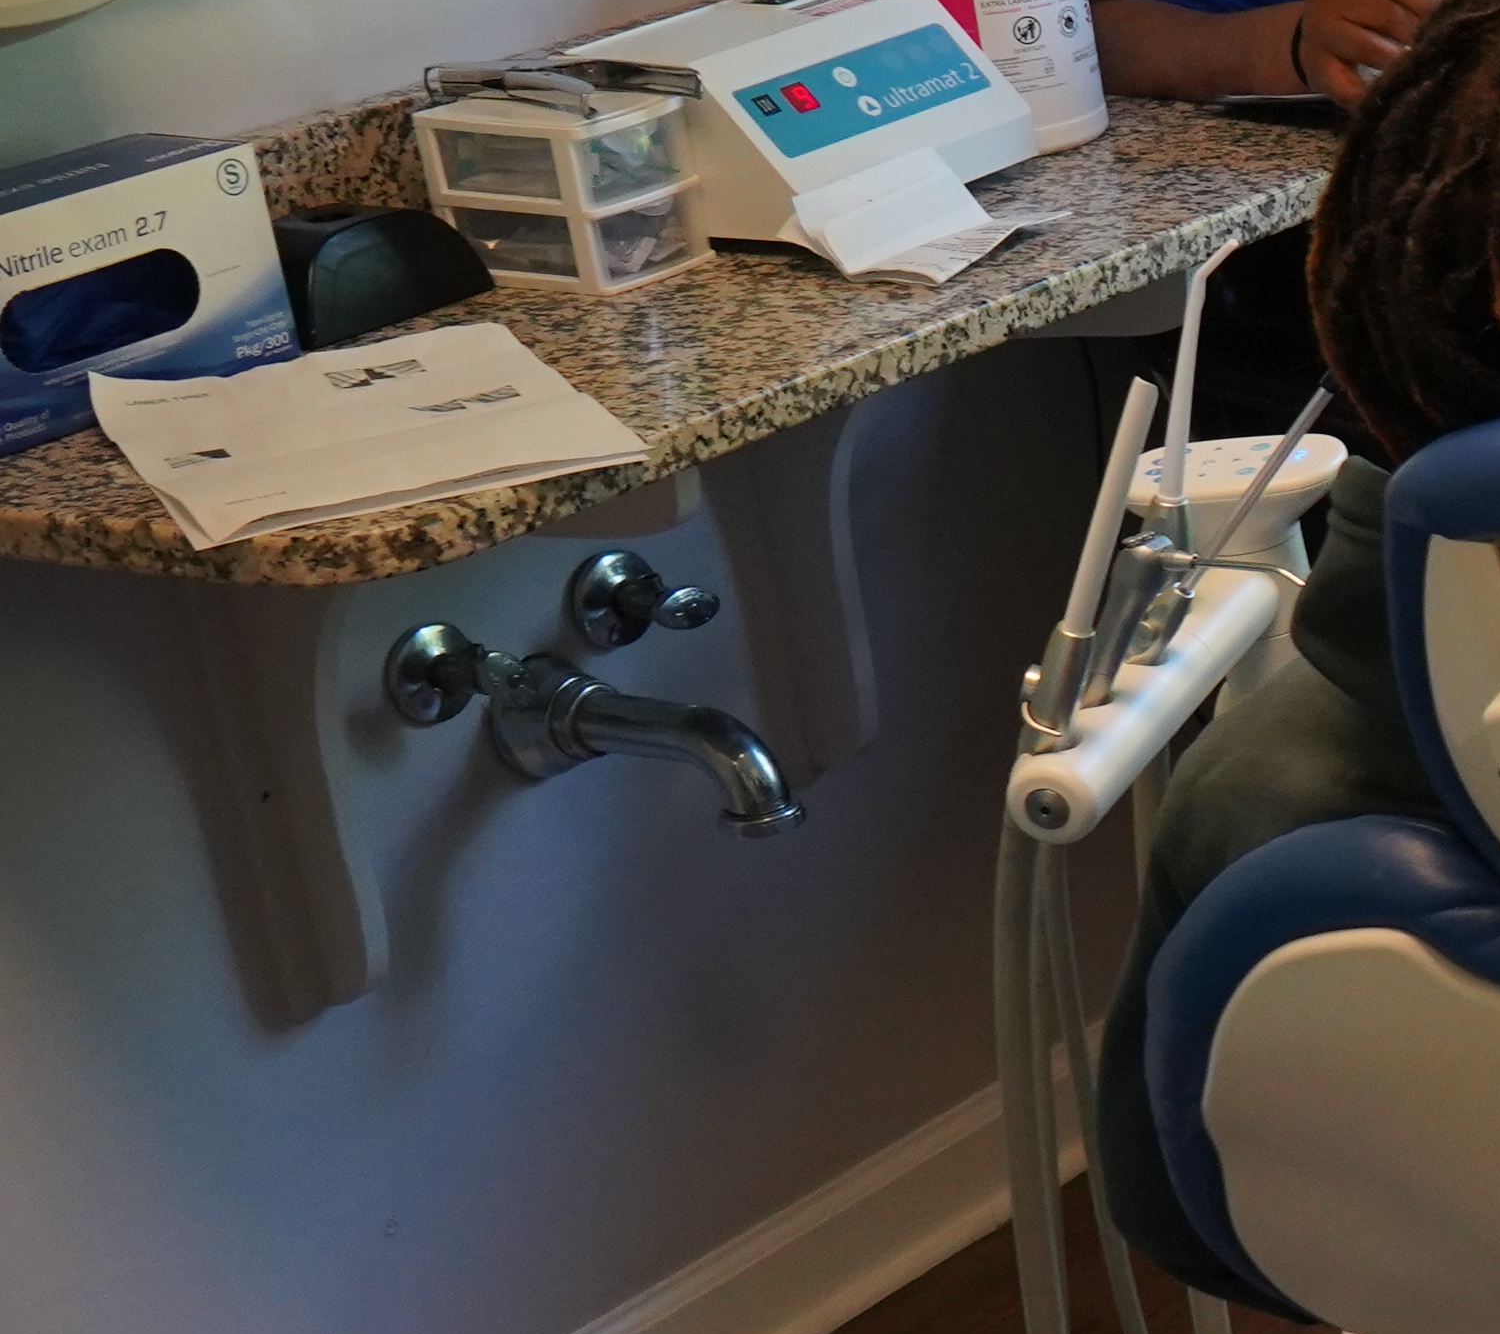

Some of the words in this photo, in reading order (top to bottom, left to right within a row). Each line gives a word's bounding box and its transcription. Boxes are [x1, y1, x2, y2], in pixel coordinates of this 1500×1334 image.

[881, 70, 965, 110] ultramat
[960, 62, 982, 80] 2
[224, 163, 242, 186] S
[68, 226, 128, 257] exam
[136, 210, 168, 238] 2.7
